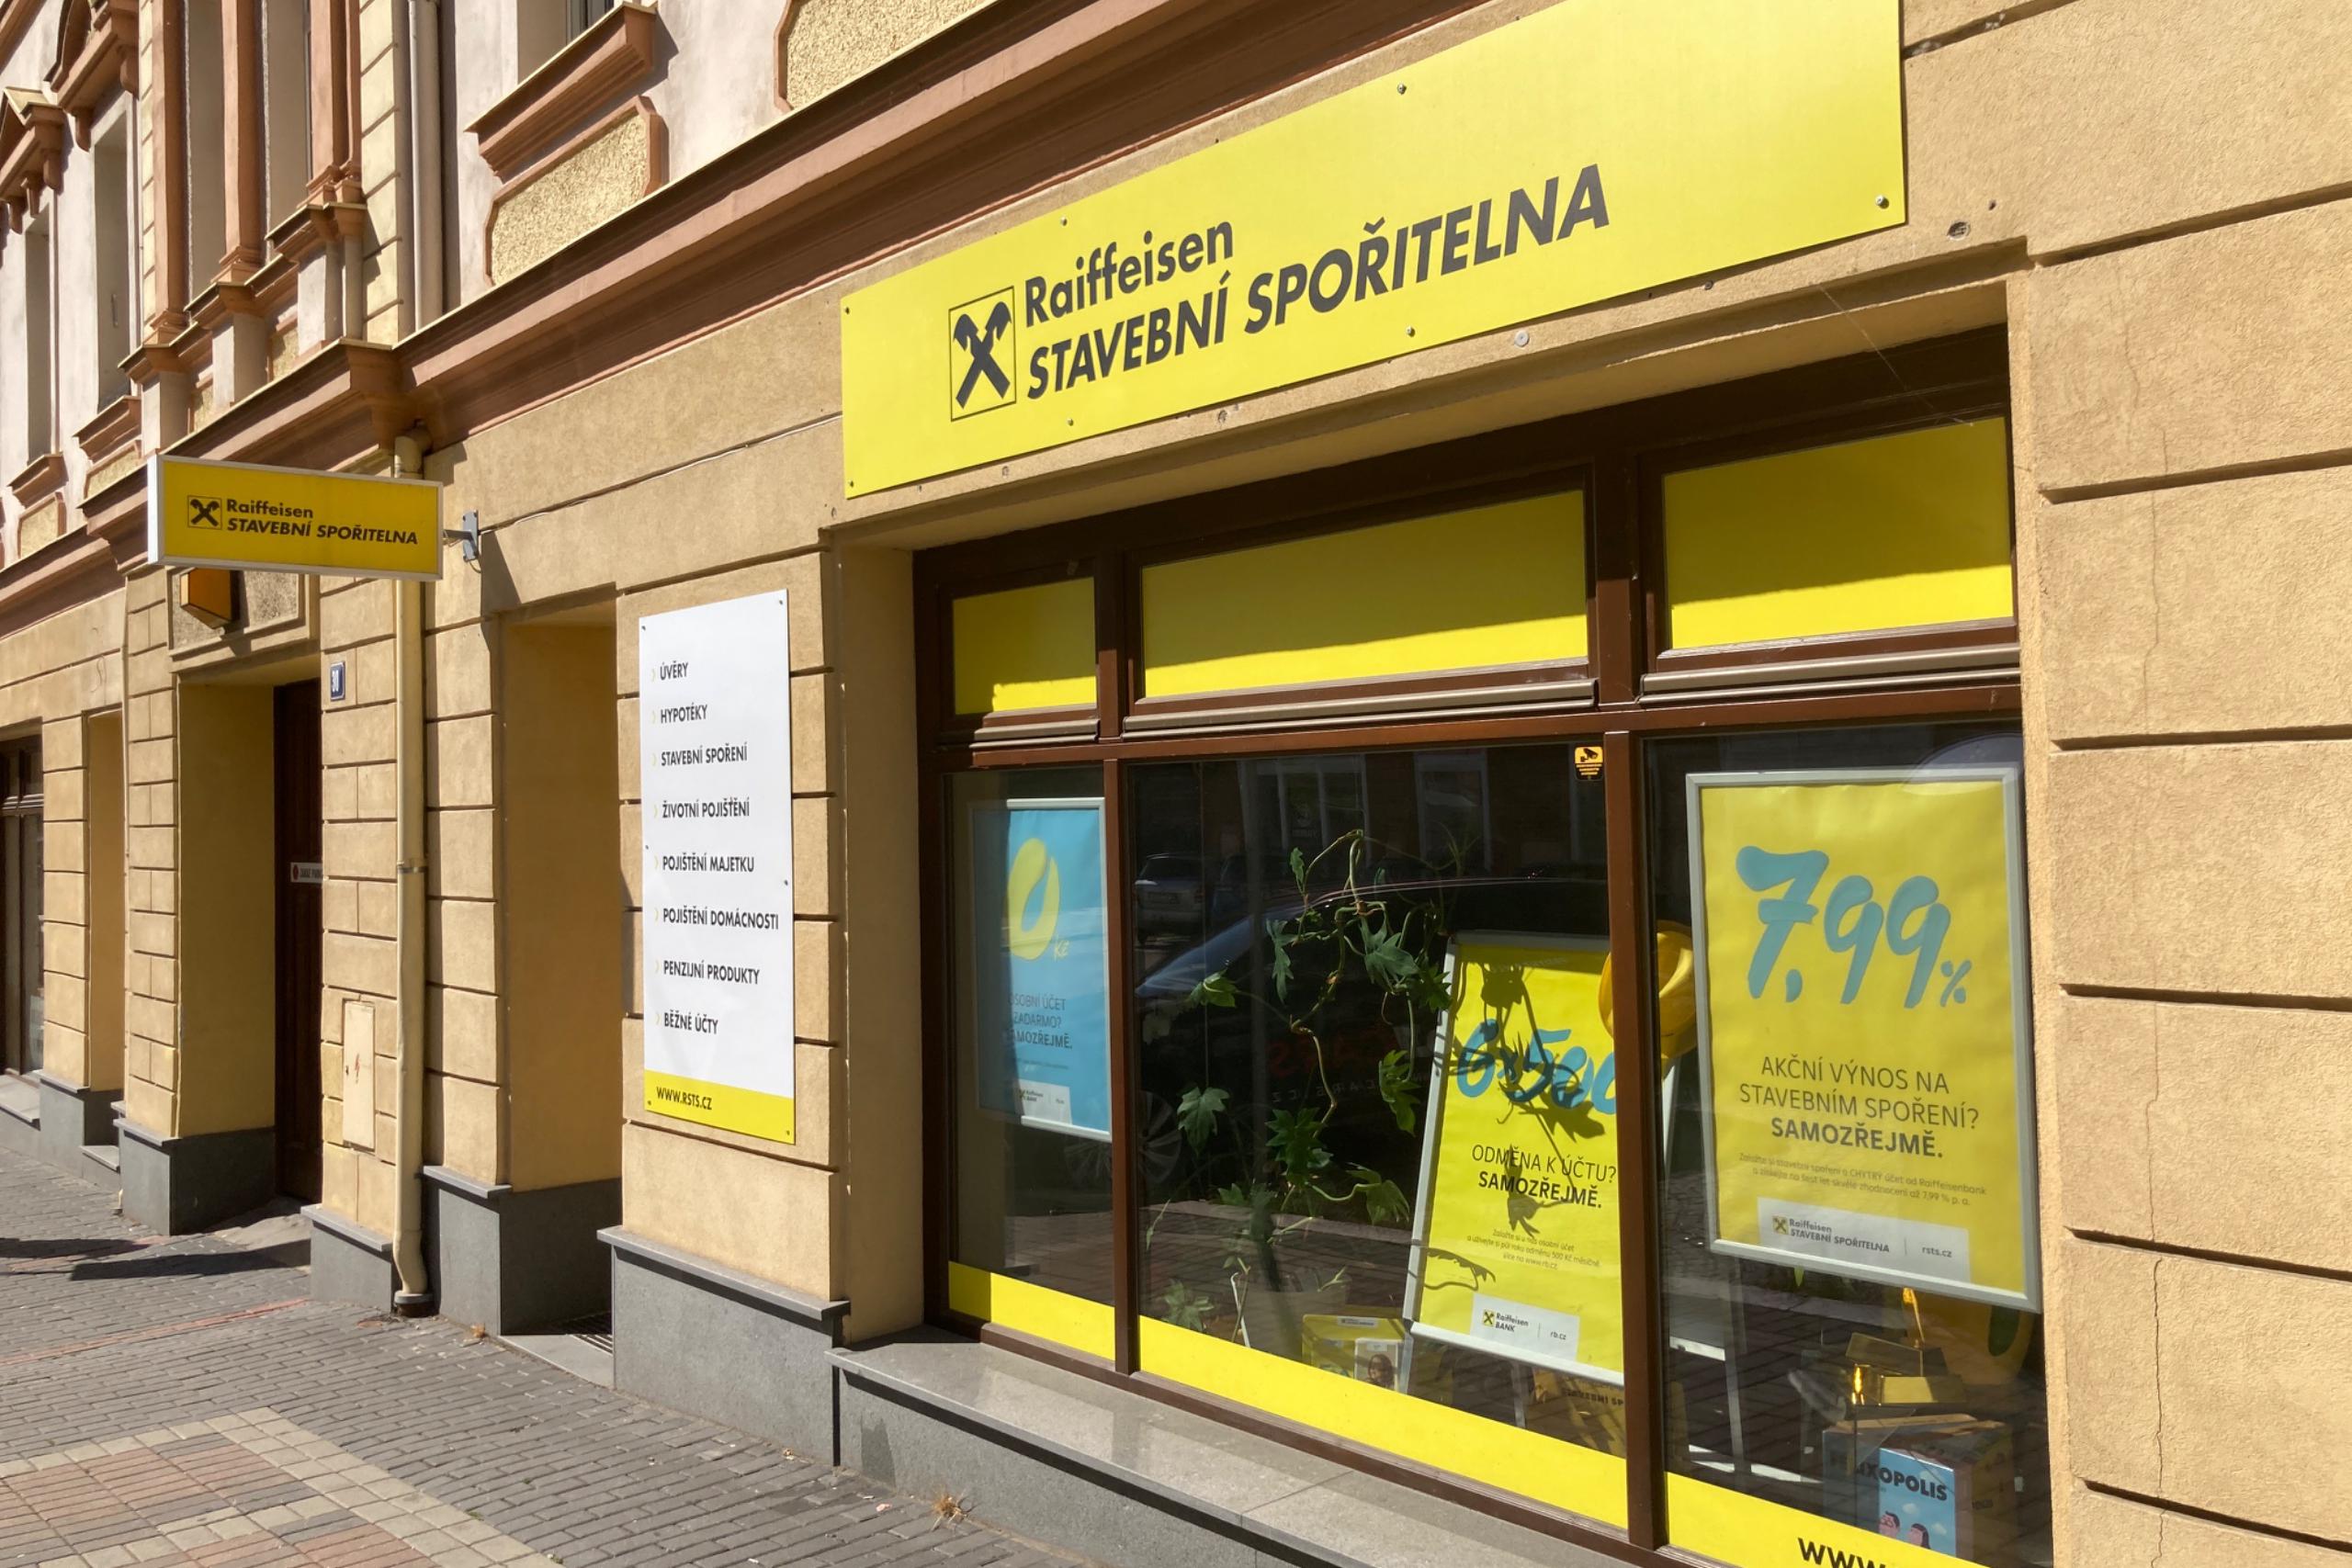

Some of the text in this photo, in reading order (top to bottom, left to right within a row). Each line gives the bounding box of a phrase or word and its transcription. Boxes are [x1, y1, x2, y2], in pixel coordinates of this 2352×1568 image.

[1026, 220, 1234, 327] Raiffeisen
[1027, 163, 1610, 400] STAVEBNÍ SPOŘITELNA
[227, 499, 313, 519] Raiffeisen
[227, 518, 418, 545] STAVEBNÍ SPOŘITELNA
[660, 660, 689, 681] ÚVĚRY
[661, 703, 708, 724] HYPOTÉKY
[661, 742, 748, 766] STAVEBNÍ SPOŘENÍ
[662, 796, 750, 818] ŽIVOTNÍ POJIŠTĚNÍ
[662, 853, 754, 872] POJIŠTĚNÍ MAJETKU
[663, 906, 779, 930] POJIŠTĚNÍ DOMÁCNOSTI
[663, 960, 760, 985] PENZIJNÍ PRODUKTY
[663, 1010, 718, 1034] BĚŽNÉ ÚČTY
[1761, 1054, 1950, 1094] AKČNÍ VÝNOS NA
[656, 1087, 713, 1111] WWW.RSTS.CZ
[1739, 1082, 1979, 1129] STAVEBNÍM SPOŘENÍ?
[1770, 1117, 1943, 1158] SAMOZŘEJMĚ.
[1472, 1144, 1616, 1183] ODMĚNA K ÚČTU?
[1478, 1170, 1601, 1209] SAMOZŘEJMĚ.
[1905, 1176, 1917, 1185] od
[1789, 1218, 1832, 1233] Raiffeisen
[1790, 1228, 1952, 1258] STAVEBNÍ SPOŘITELNA rsts.cz
[1495, 1322, 1516, 1332] BANK
[1496, 1312, 1529, 1326] Raiffeisen
